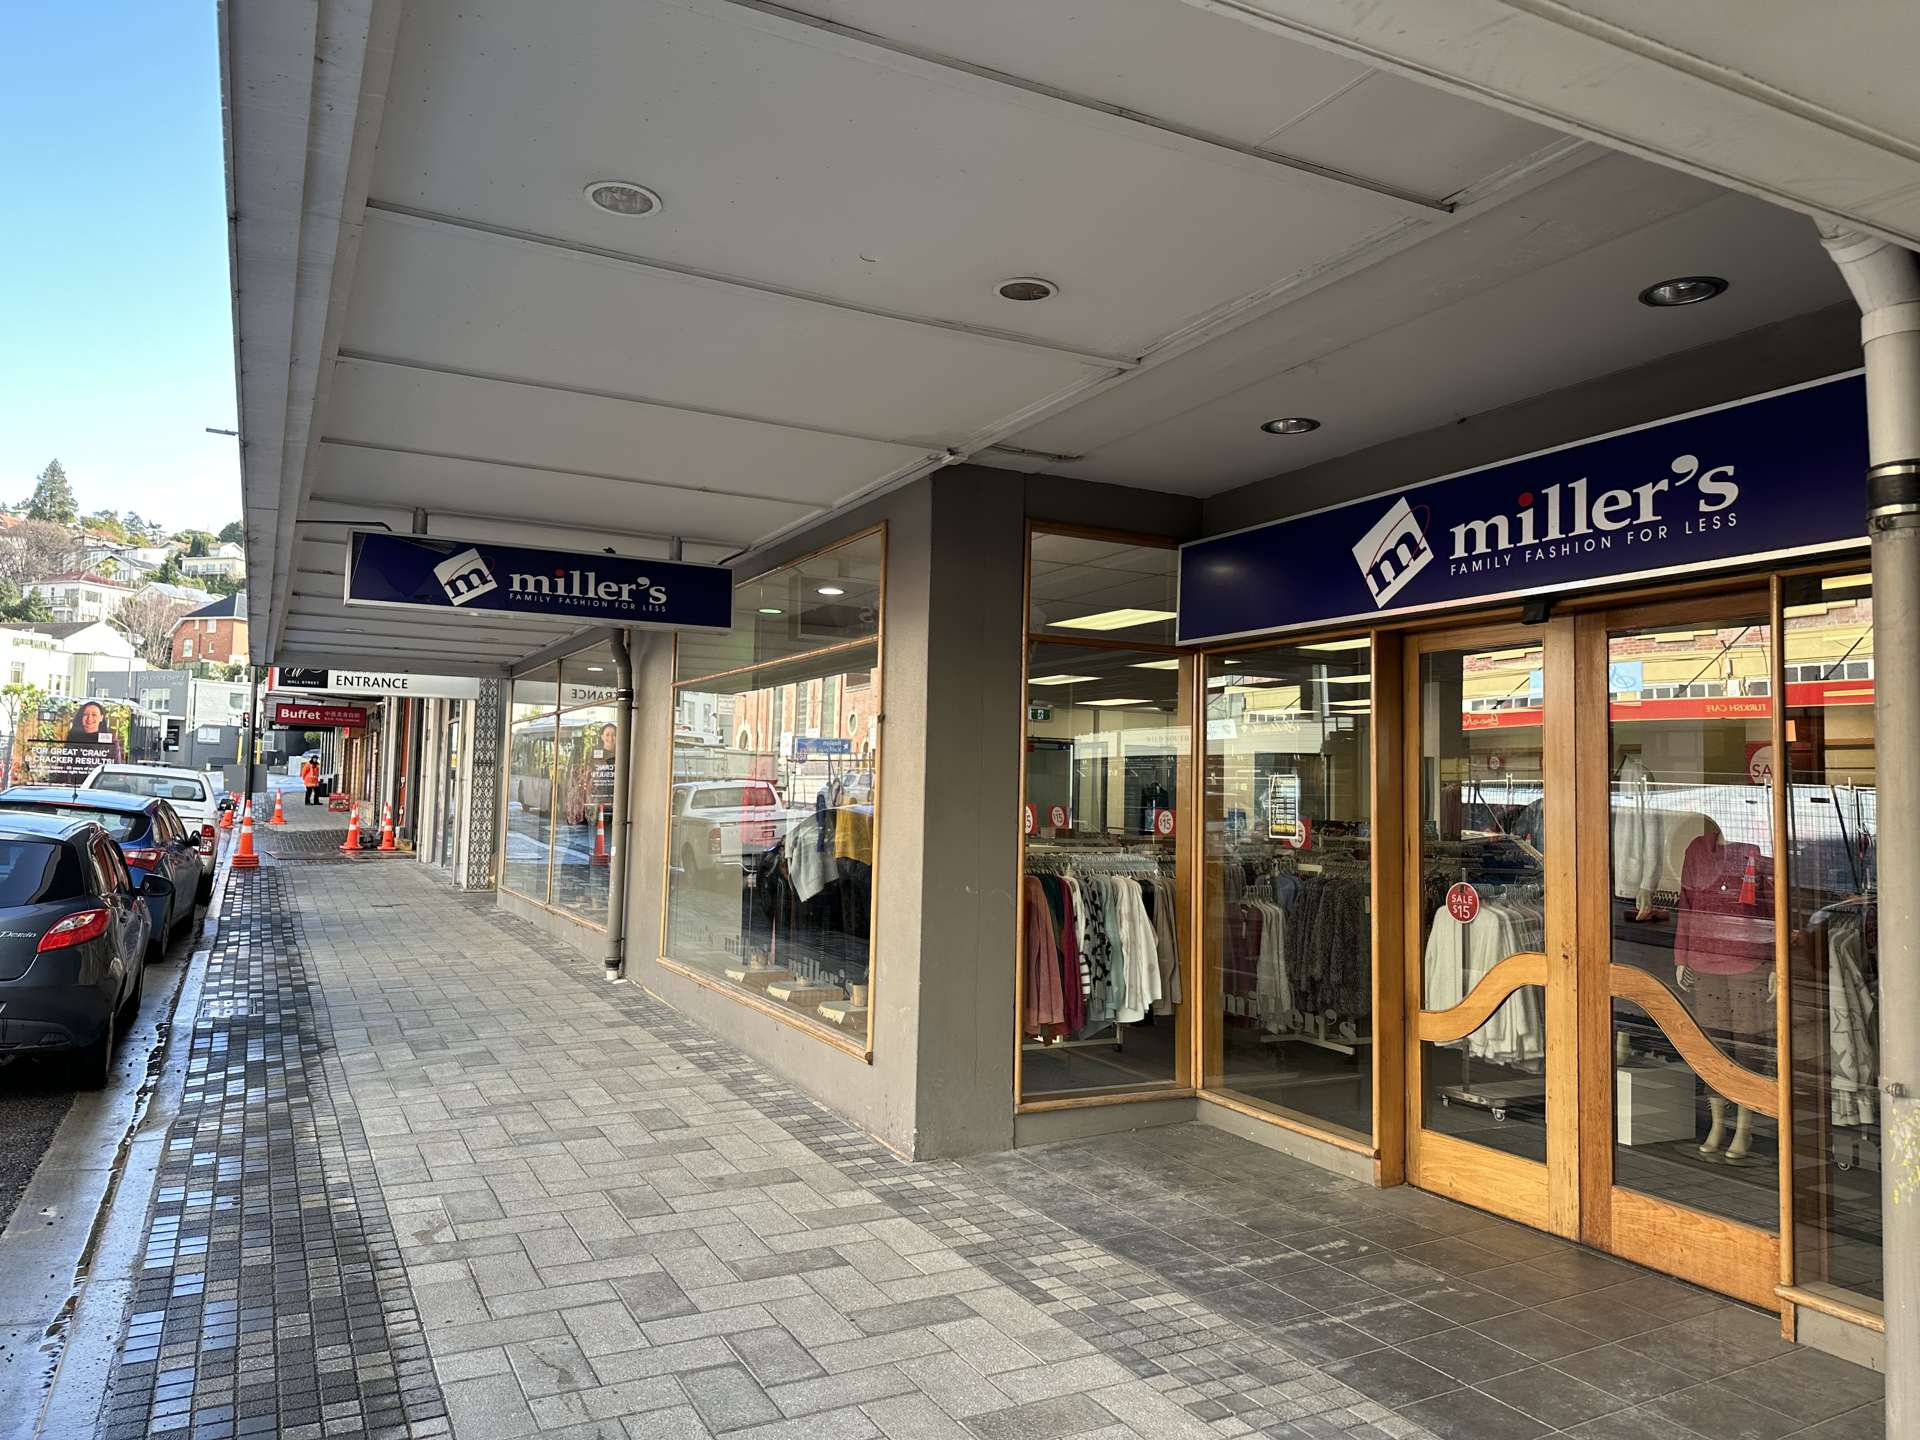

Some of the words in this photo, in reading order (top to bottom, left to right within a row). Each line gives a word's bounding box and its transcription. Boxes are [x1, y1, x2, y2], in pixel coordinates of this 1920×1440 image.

[1449, 454, 1740, 560] miller's
[1450, 554, 1512, 576] FAMILY
[1525, 535, 1612, 564] FASHION
[1627, 525, 1668, 545] FOR
[1685, 512, 1738, 535] LESS
[508, 568, 668, 605] miller's
[509, 592, 550, 603] FAMILY
[558, 596, 608, 608] FASHION
[614, 601, 636, 610] FOR
[642, 604, 667, 613] LESS
[336, 675, 409, 689] ENTRANCE
[281, 708, 321, 720] Buffet
[50, 748, 79, 756] GREAT
[80, 748, 110, 757] 'CRAIC'
[33, 756, 73, 764] CRACKER
[1451, 894, 1473, 905] SALE
[1452, 904, 1470, 919] $15
